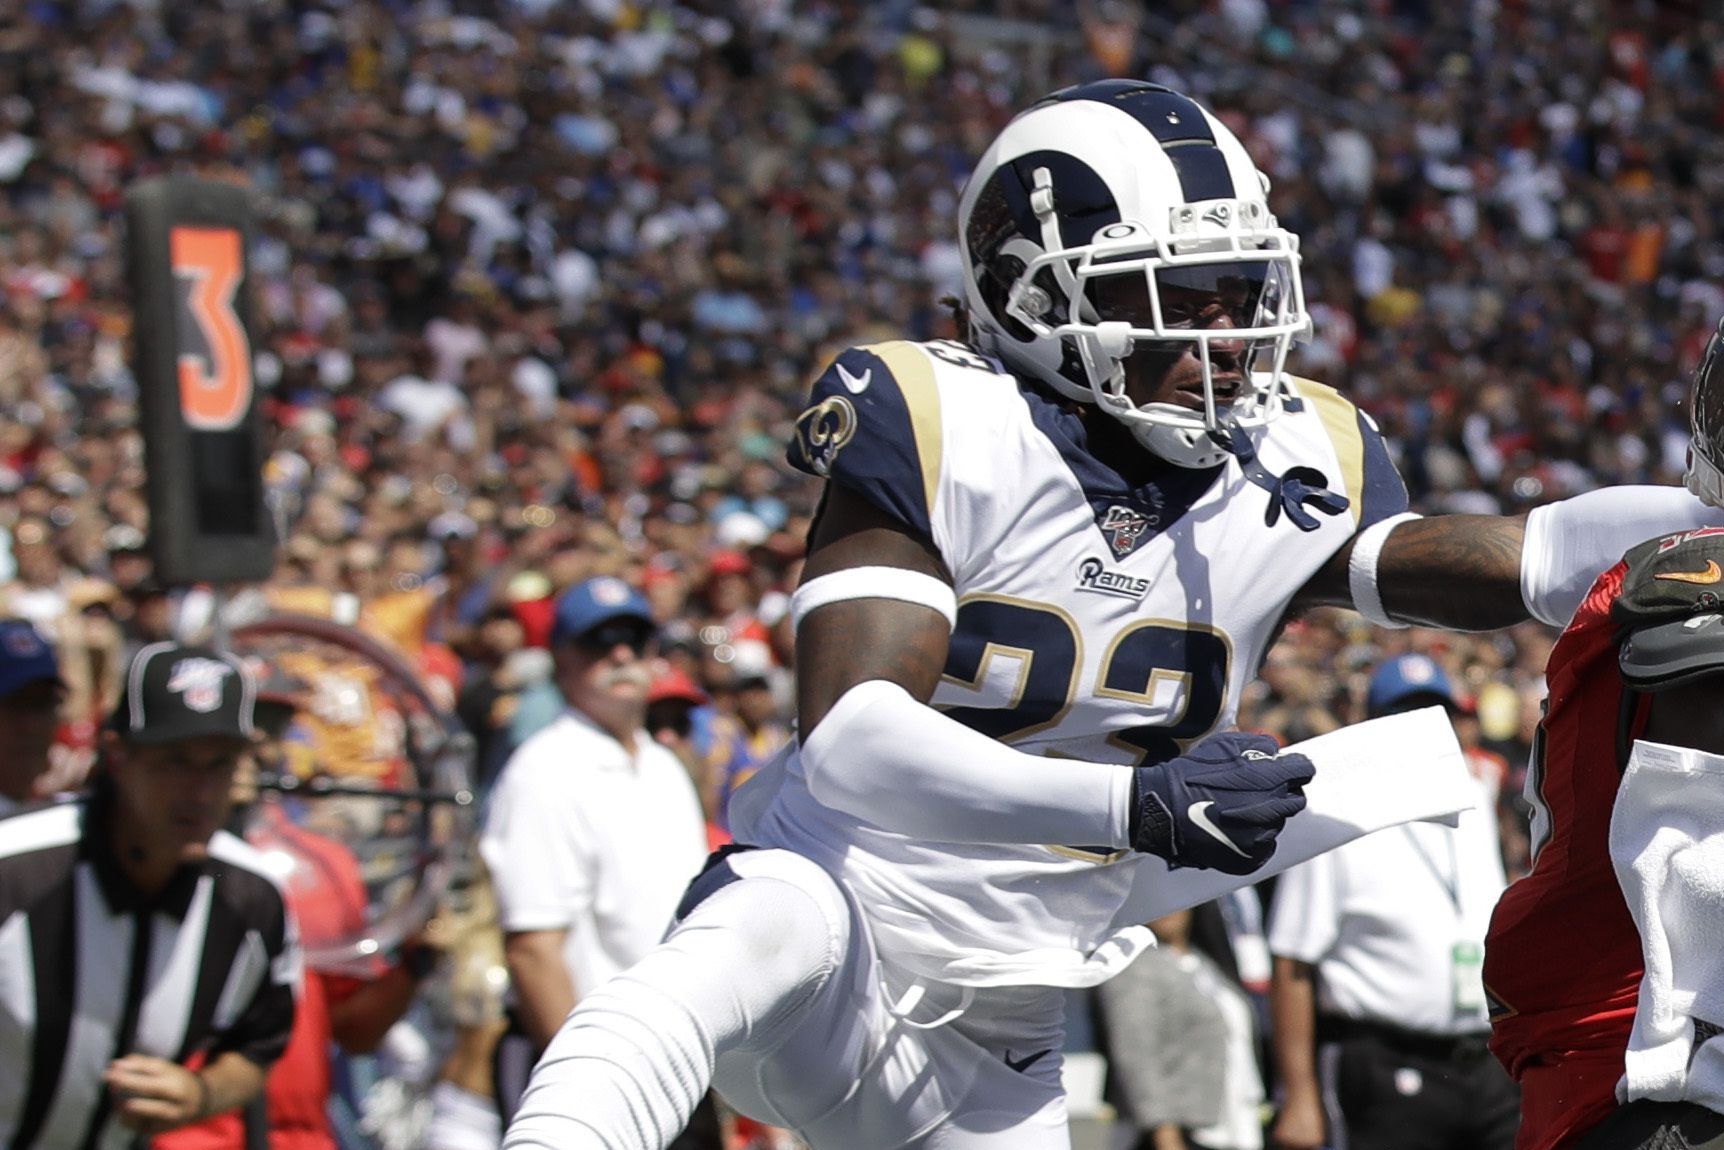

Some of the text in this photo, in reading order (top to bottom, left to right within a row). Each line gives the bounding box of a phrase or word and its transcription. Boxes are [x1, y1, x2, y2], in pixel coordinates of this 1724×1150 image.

[169, 225, 253, 431] 3
[1078, 556, 1151, 599] Rams
[926, 592, 1234, 768] 23
